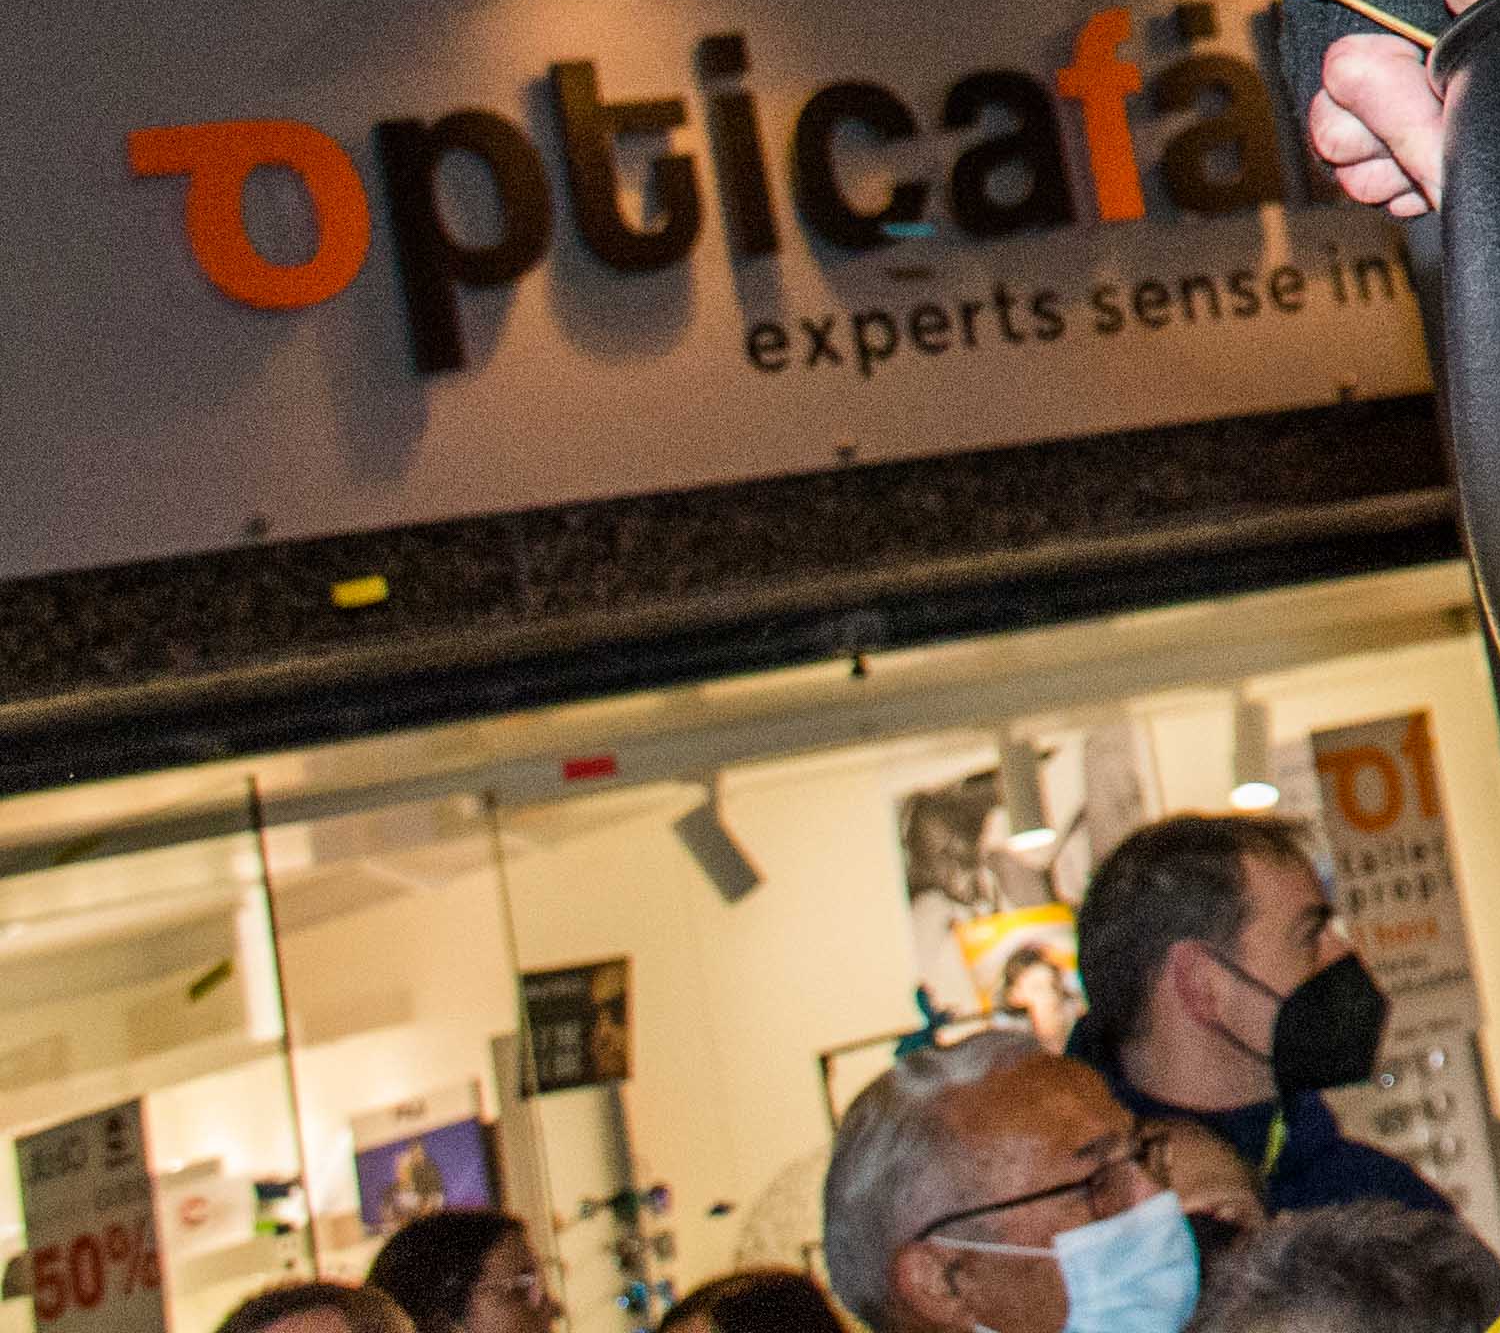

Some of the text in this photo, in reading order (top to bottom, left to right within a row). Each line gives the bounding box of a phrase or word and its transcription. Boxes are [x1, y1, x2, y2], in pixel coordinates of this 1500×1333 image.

[746, 284, 1066, 378] experts
[1092, 265, 1303, 334] sense
[33, 1215, 162, 1322] 50%
